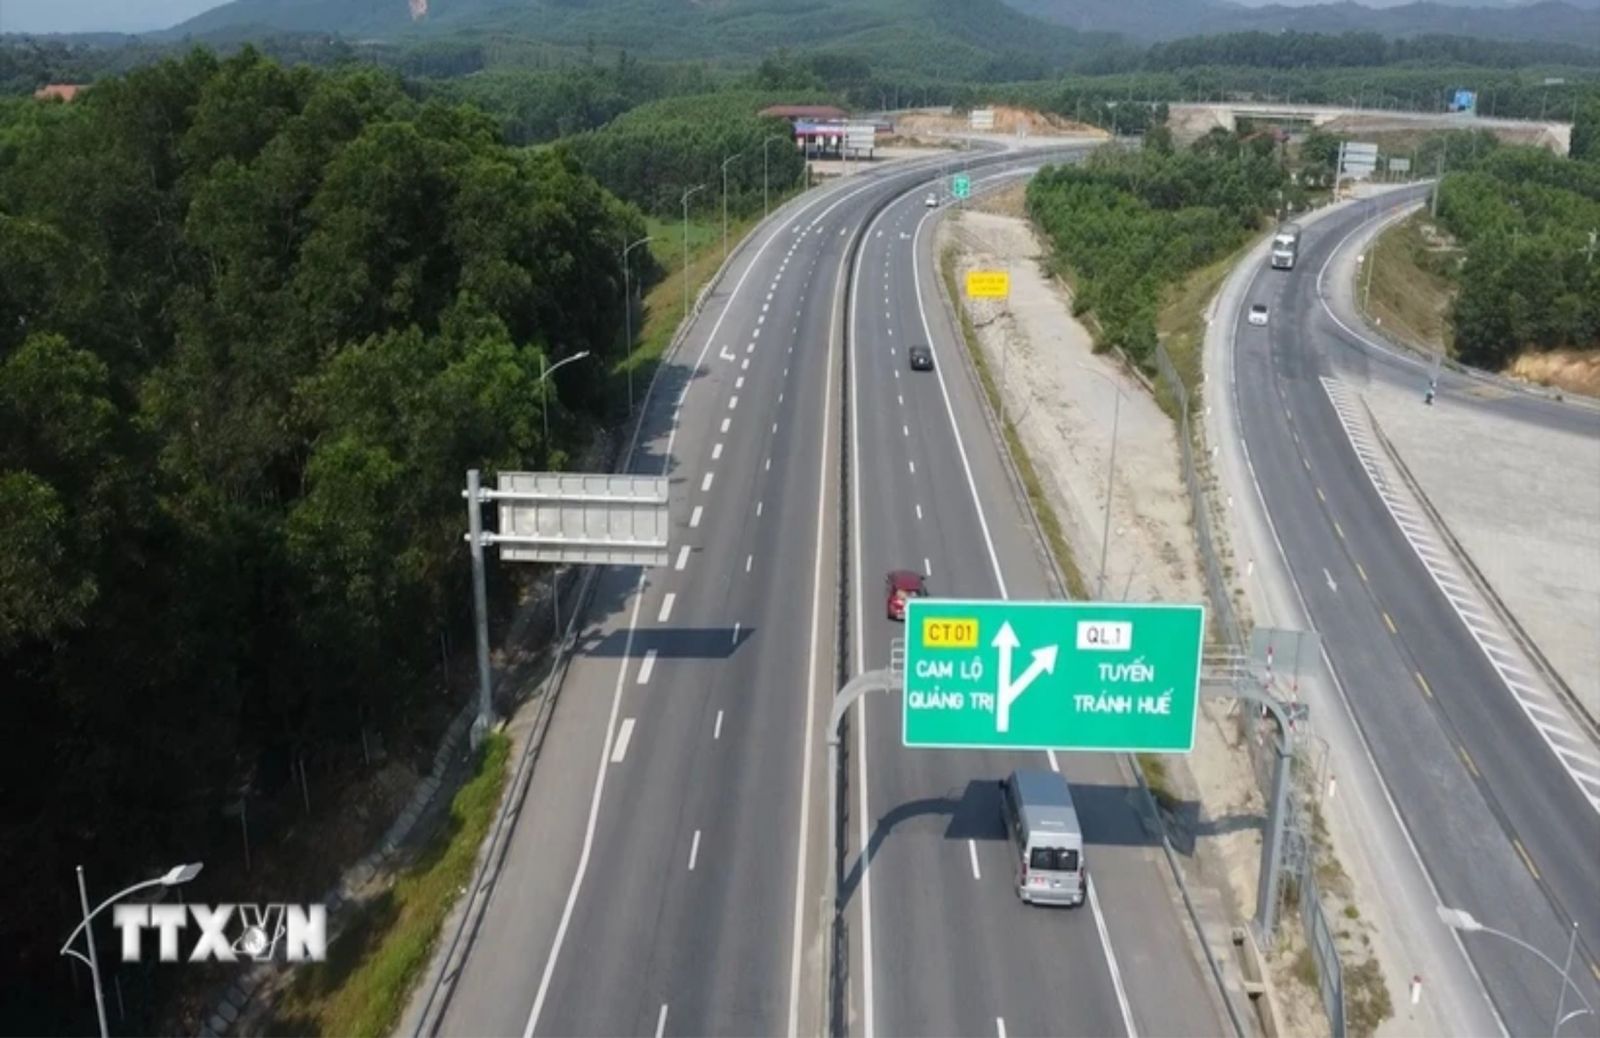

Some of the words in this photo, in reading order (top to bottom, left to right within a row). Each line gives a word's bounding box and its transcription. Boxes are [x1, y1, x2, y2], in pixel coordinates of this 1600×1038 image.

[916, 660, 953, 679] CAM
[960, 655, 984, 683] LỘ
[1098, 655, 1154, 682] TUYẾN
[908, 685, 964, 709] QUẢNG
[969, 691, 994, 714] TRỊ
[1073, 690, 1132, 714] TRÁNH
[1137, 687, 1174, 715] HUẾ
